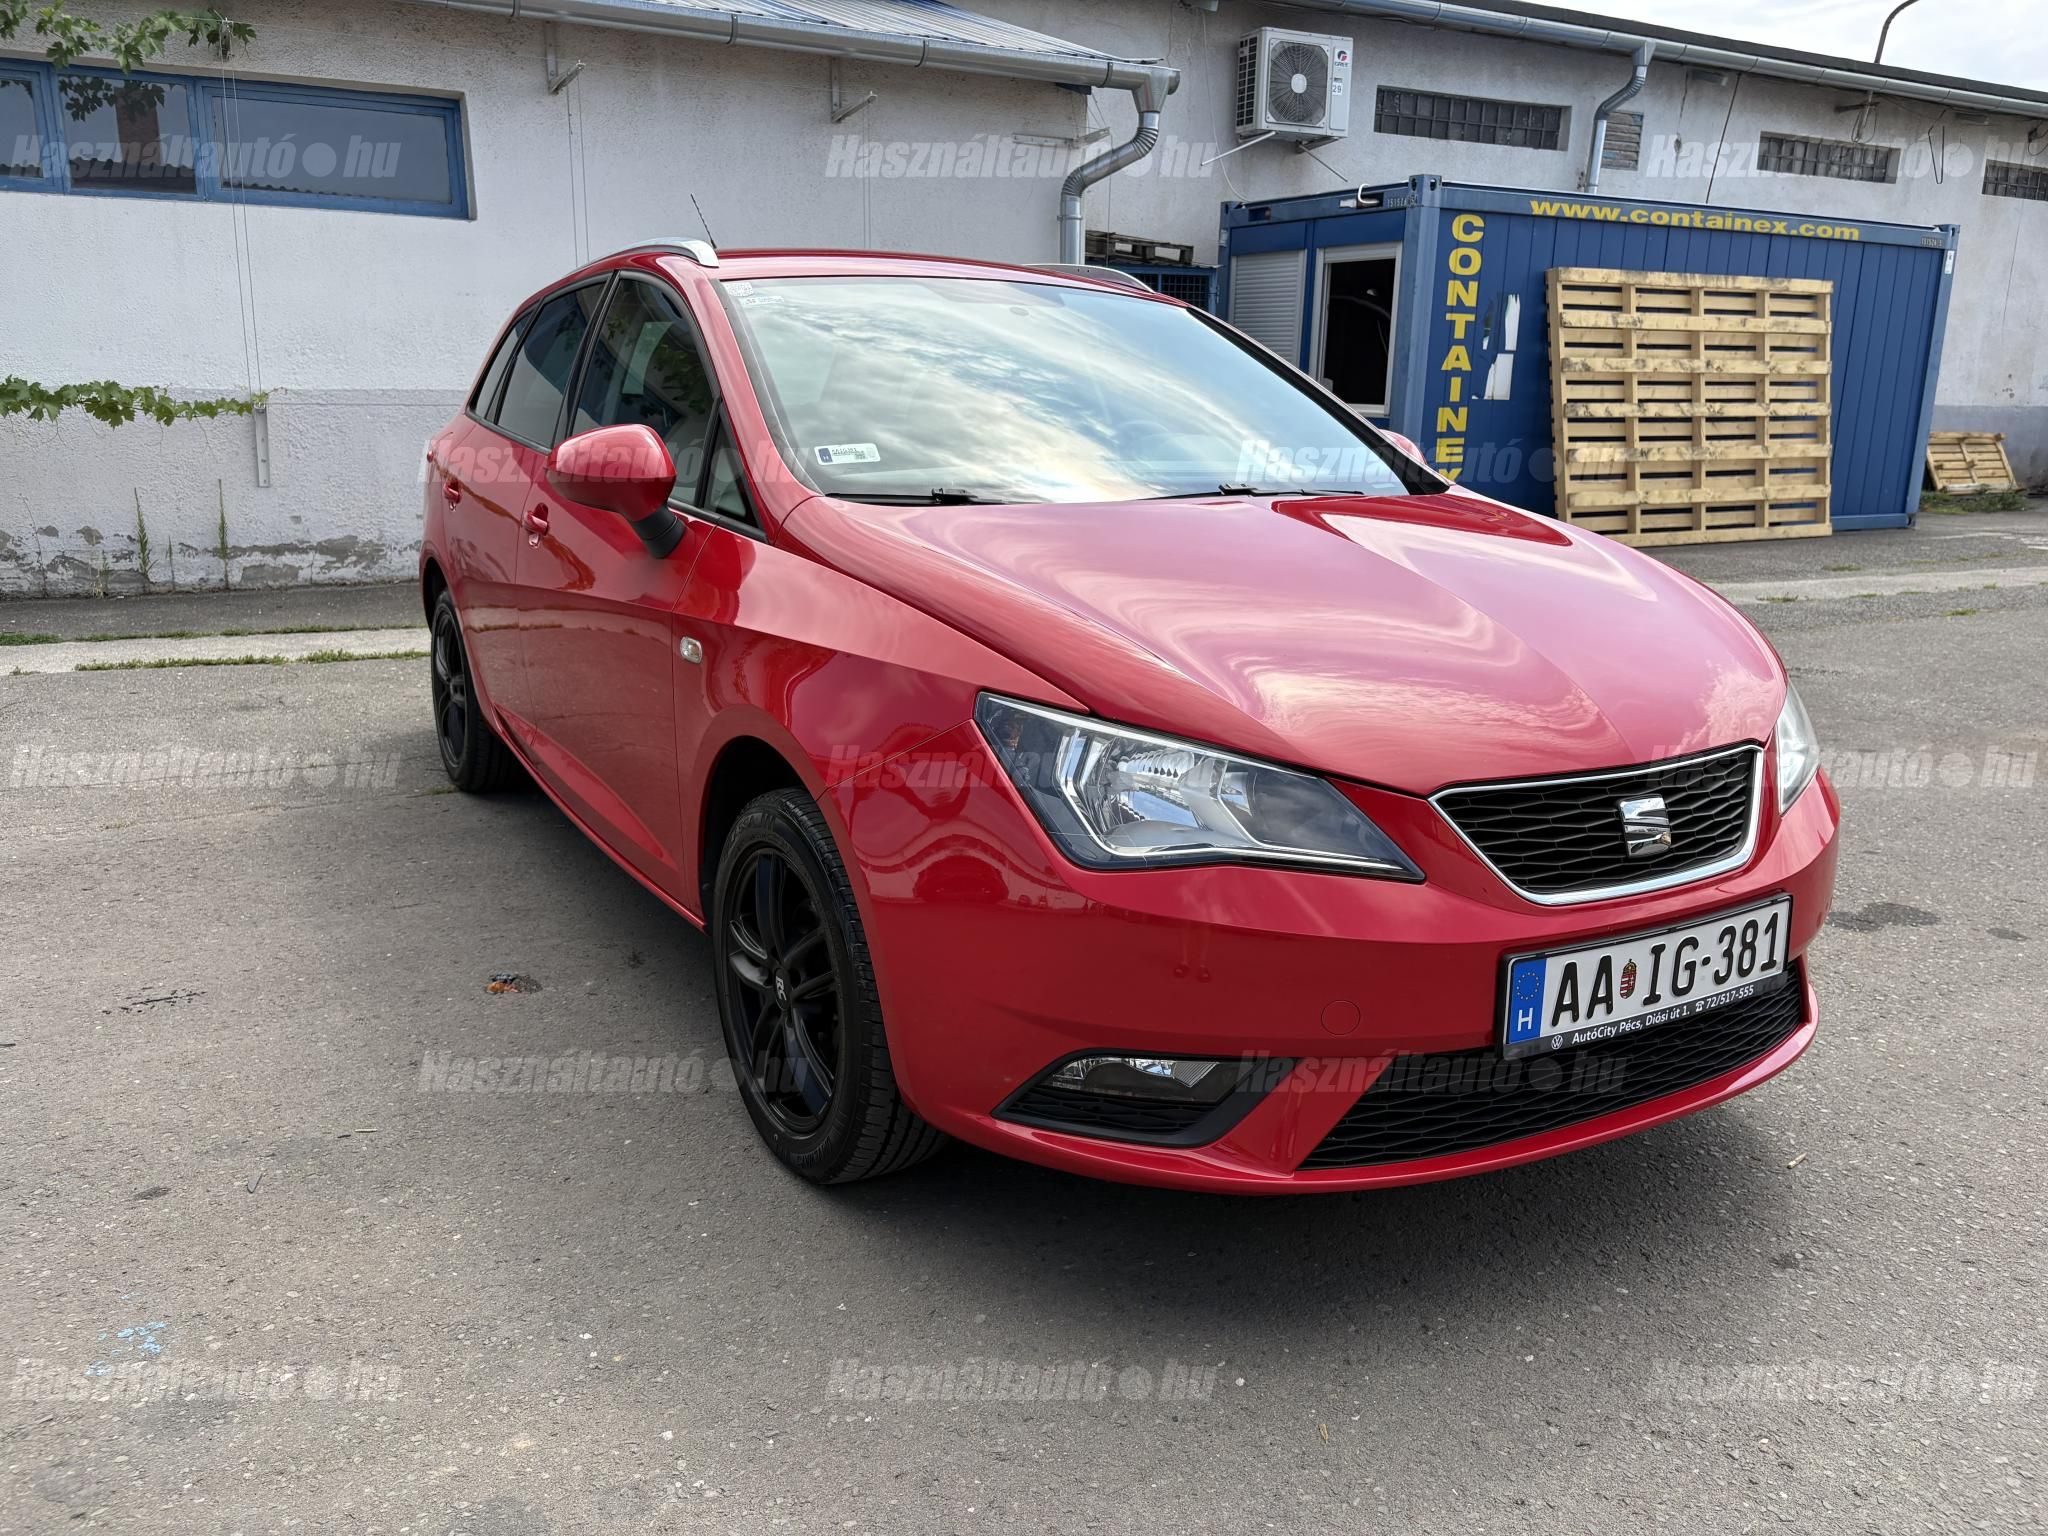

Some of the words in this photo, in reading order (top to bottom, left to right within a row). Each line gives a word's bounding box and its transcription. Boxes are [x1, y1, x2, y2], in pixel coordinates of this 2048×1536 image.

[1529, 200, 1860, 241] www.containex.com
[1642, 911, 1779, 1006] IG-381
[1517, 1007, 1533, 1032] H
[1571, 1025, 1617, 1045] AutóCity
[1619, 1019, 1643, 1033] Pécs,
[1644, 1009, 1668, 1026] Diósi
[1670, 1007, 1680, 1019] út
[1682, 1005, 1690, 1016] 1.
[1706, 985, 1754, 1009] 72/517-555
